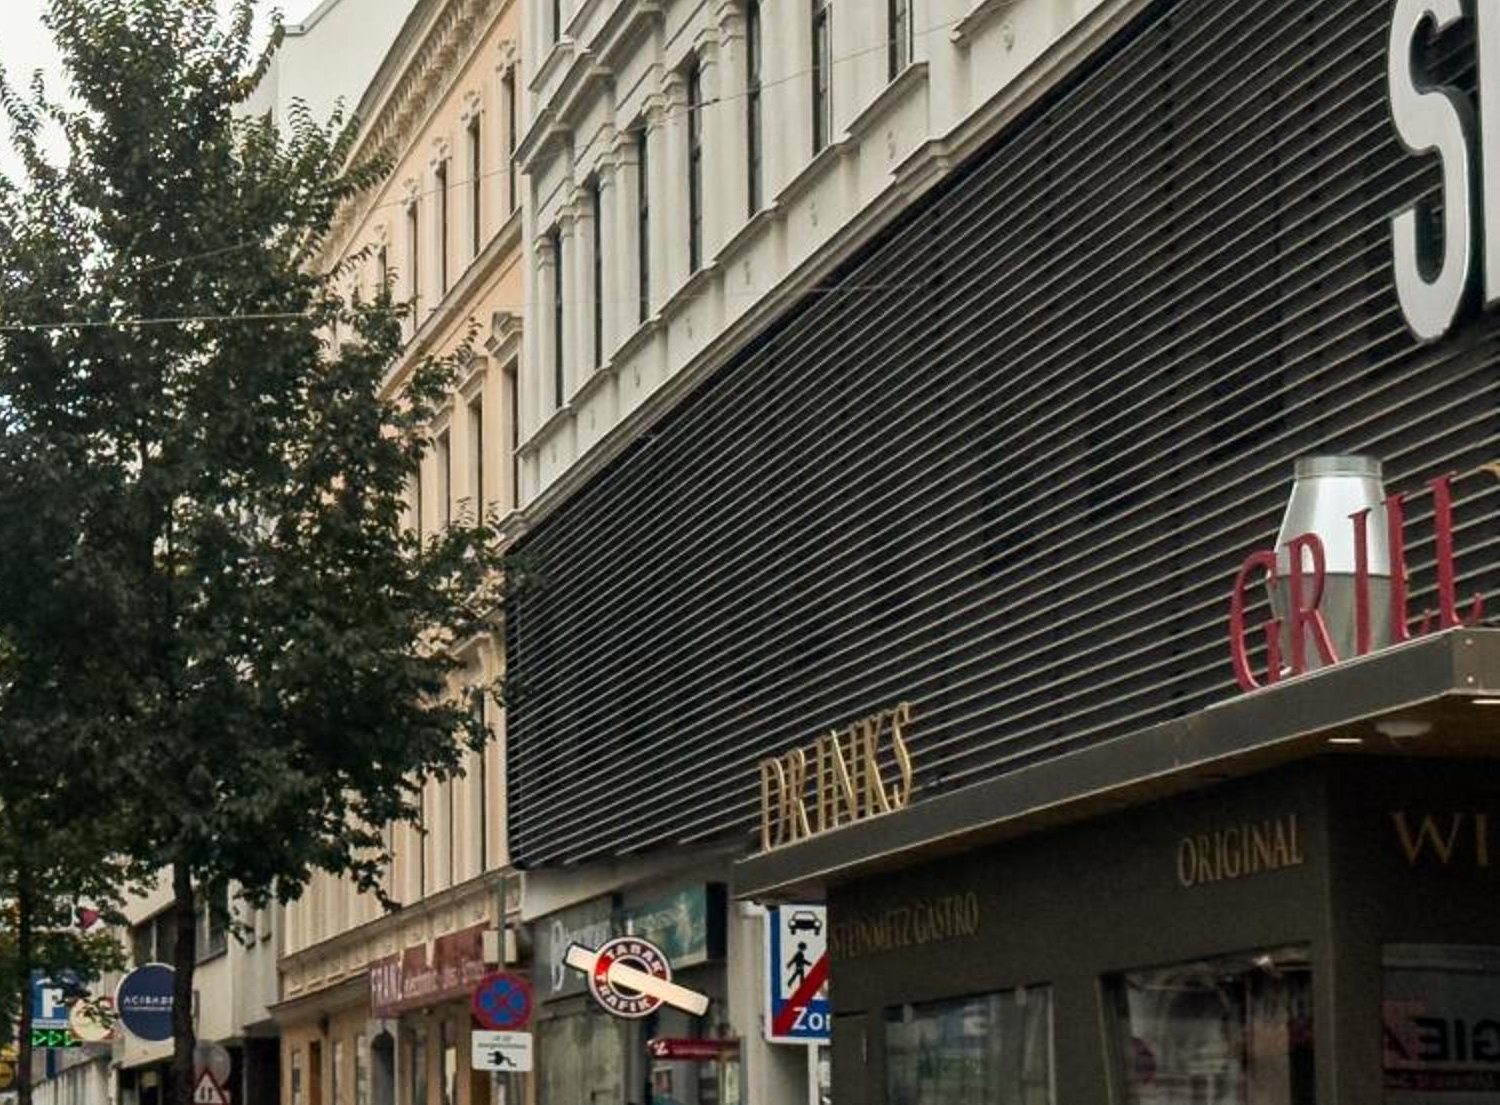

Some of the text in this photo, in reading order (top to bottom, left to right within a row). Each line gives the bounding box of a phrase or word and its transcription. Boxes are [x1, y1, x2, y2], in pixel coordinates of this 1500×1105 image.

[1229, 470, 1485, 693] GRILL
[759, 701, 913, 853] DRINKS
[1177, 814, 1304, 887] ORIGINAL
[913, 892, 980, 944] GASTRO
[607, 944, 664, 975] TABAK
[595, 974, 652, 1012] TRAFIK
